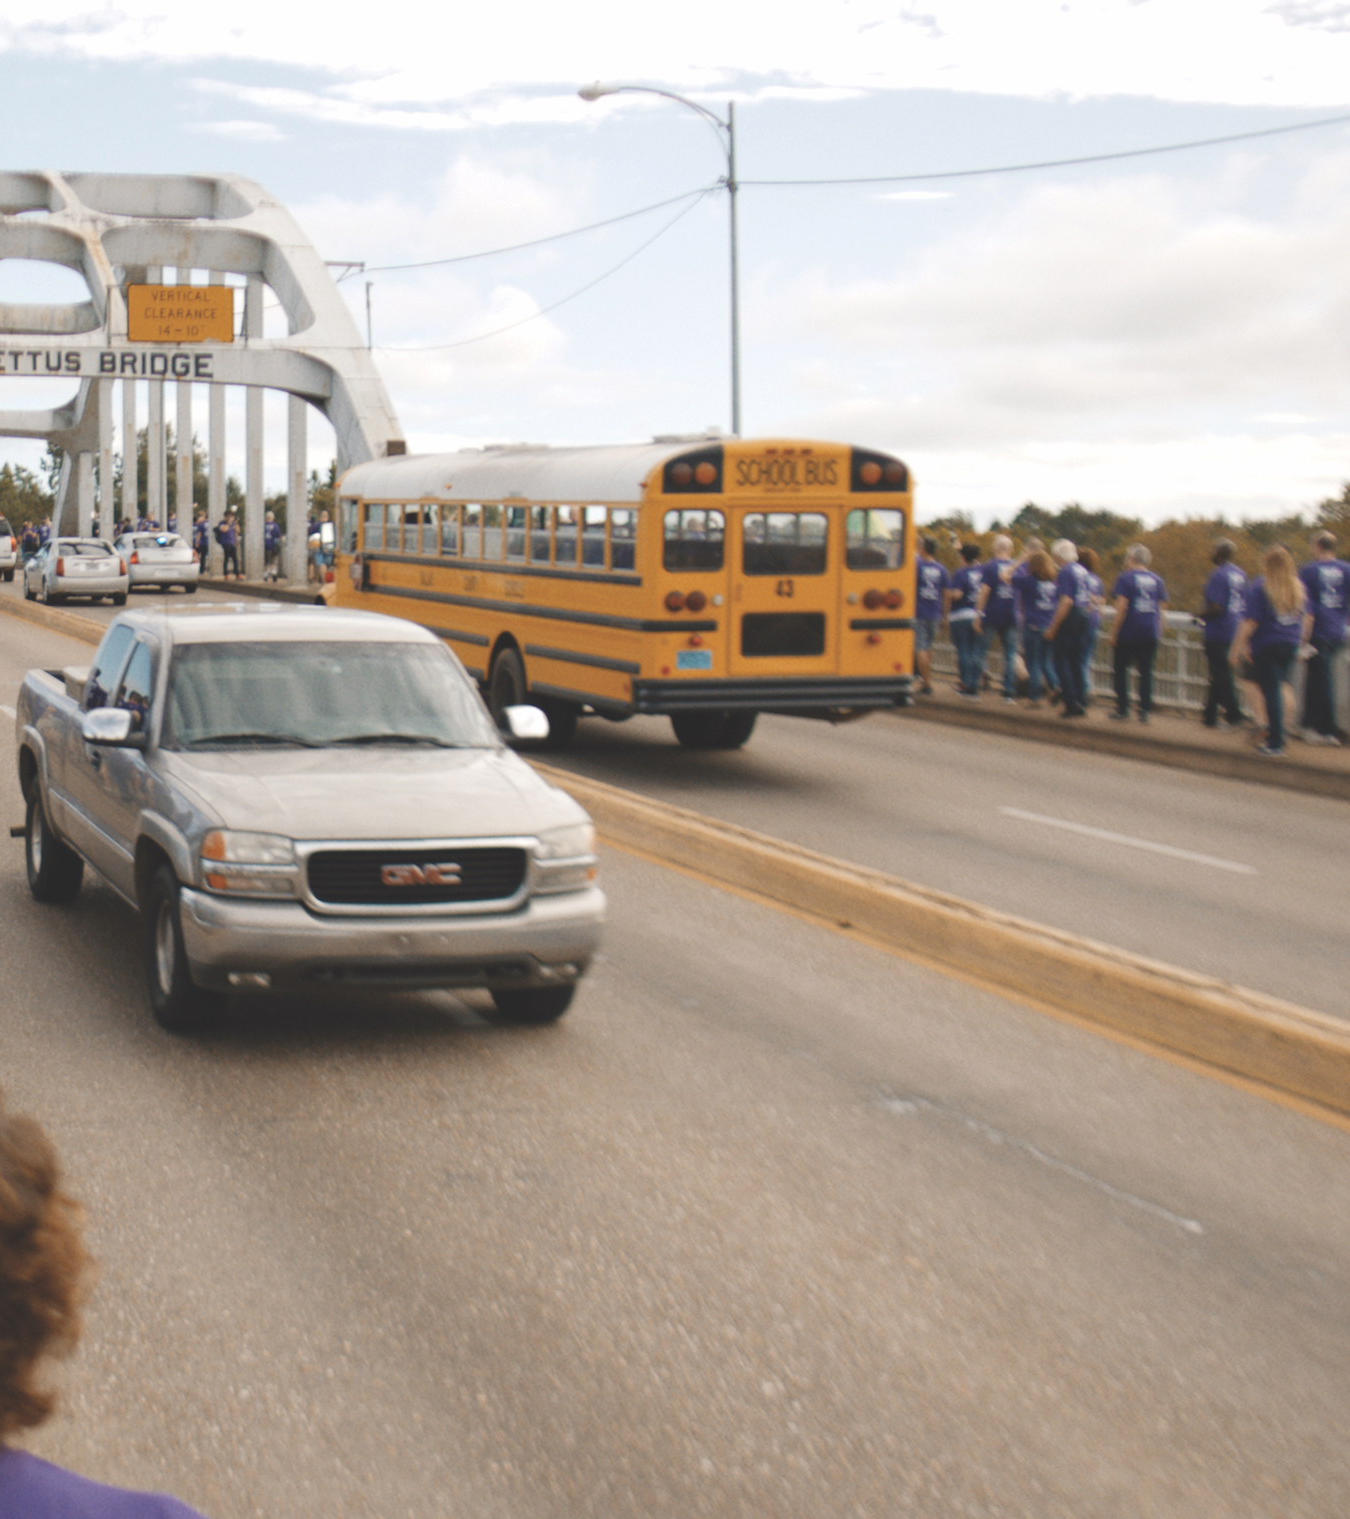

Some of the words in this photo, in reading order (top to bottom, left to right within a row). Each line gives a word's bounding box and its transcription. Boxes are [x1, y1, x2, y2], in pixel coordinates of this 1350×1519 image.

[152, 290, 210, 302] VERTICAL
[144, 308, 218, 320] CLEARANCE
[100, 353, 214, 379] BRIDGE
[736, 459, 802, 486] SCHOOL
[804, 459, 838, 486] BUS
[381, 863, 462, 886] GMC
